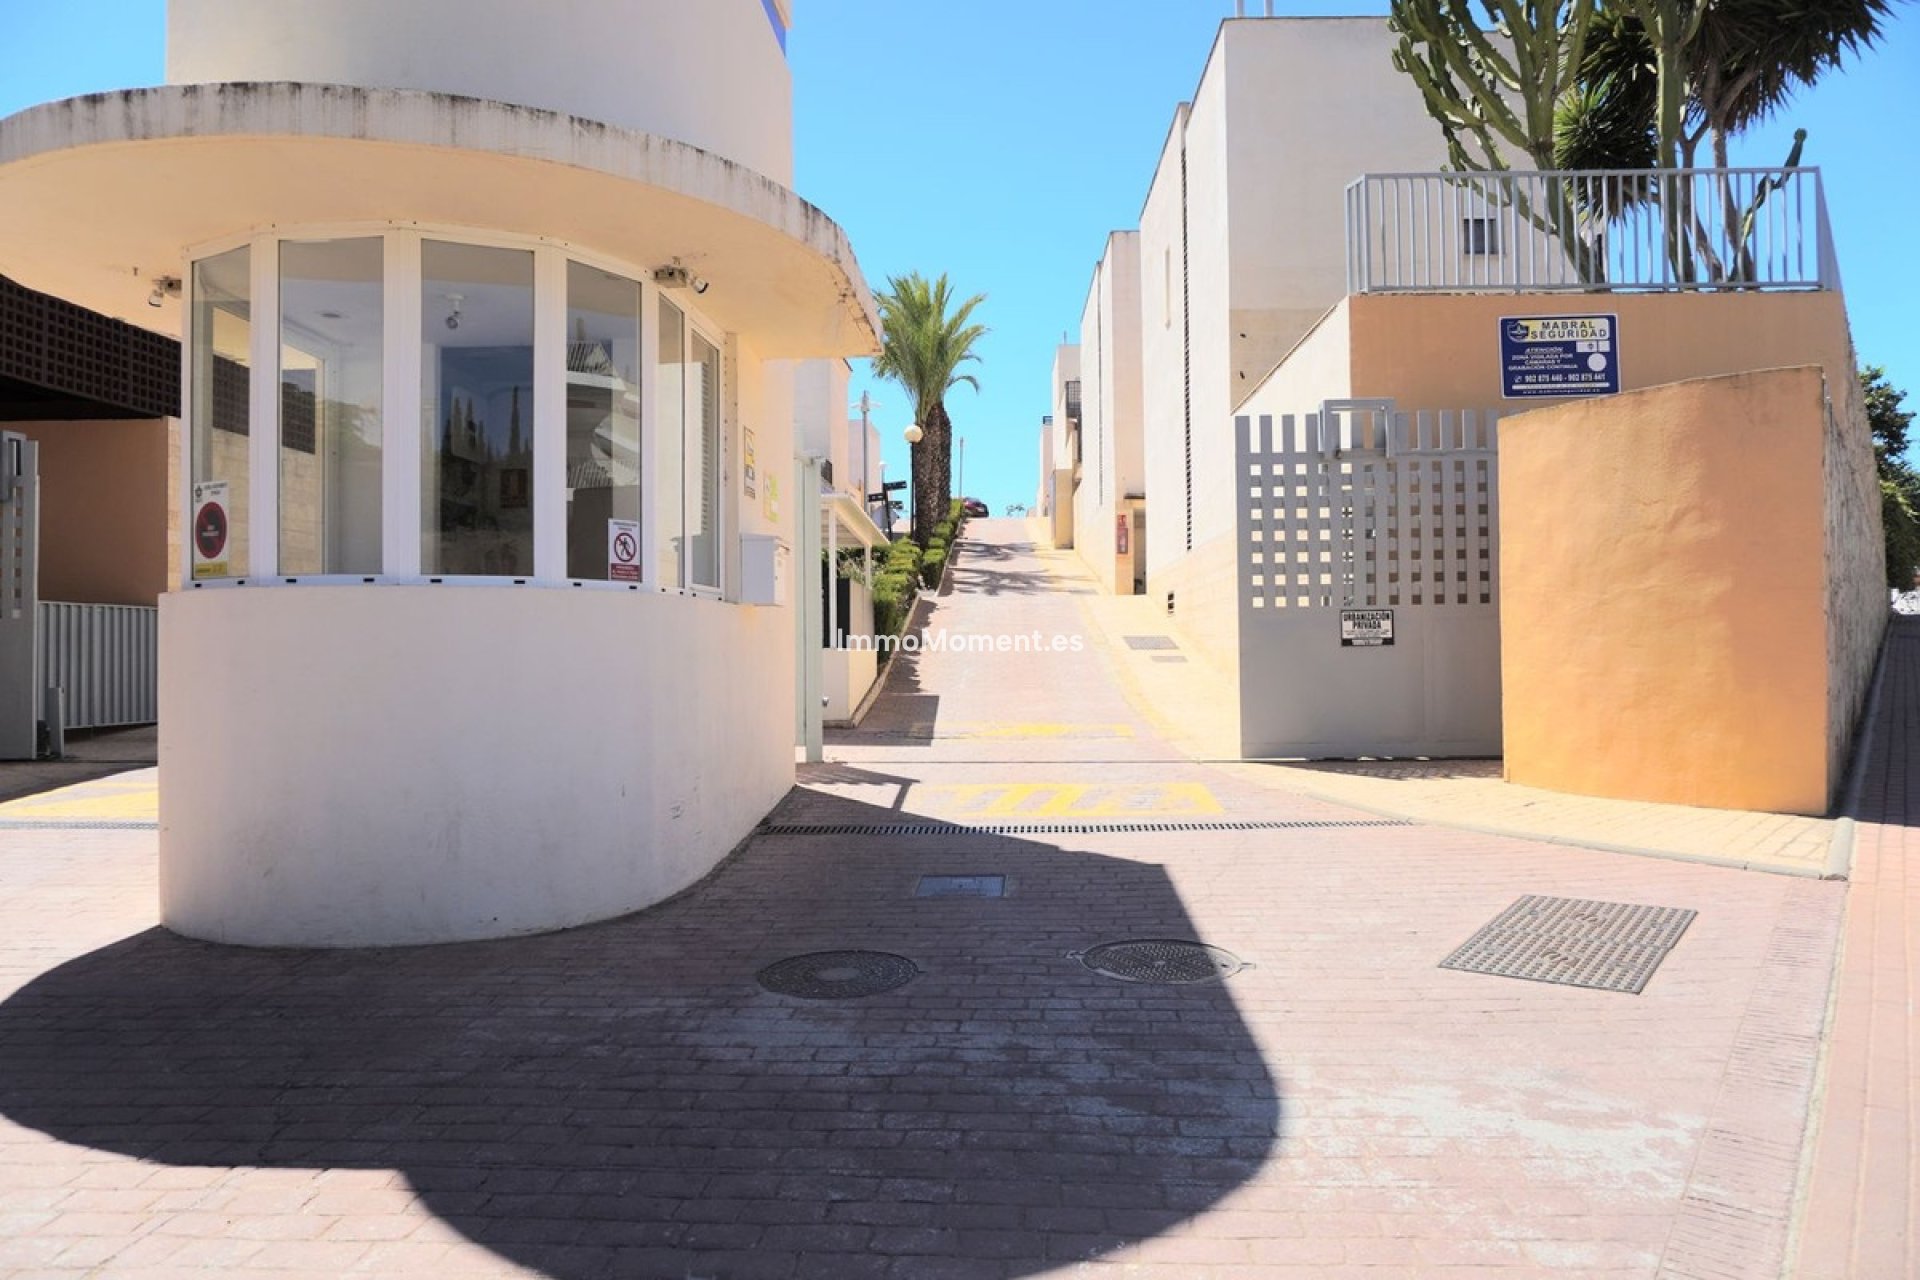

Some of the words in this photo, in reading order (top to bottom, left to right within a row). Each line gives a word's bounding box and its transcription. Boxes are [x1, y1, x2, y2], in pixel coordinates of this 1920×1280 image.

[1542, 321, 1595, 329] MABRAL
[1531, 329, 1606, 339] SEGURIDAD
[1352, 620, 1381, 629] PRIVADA
